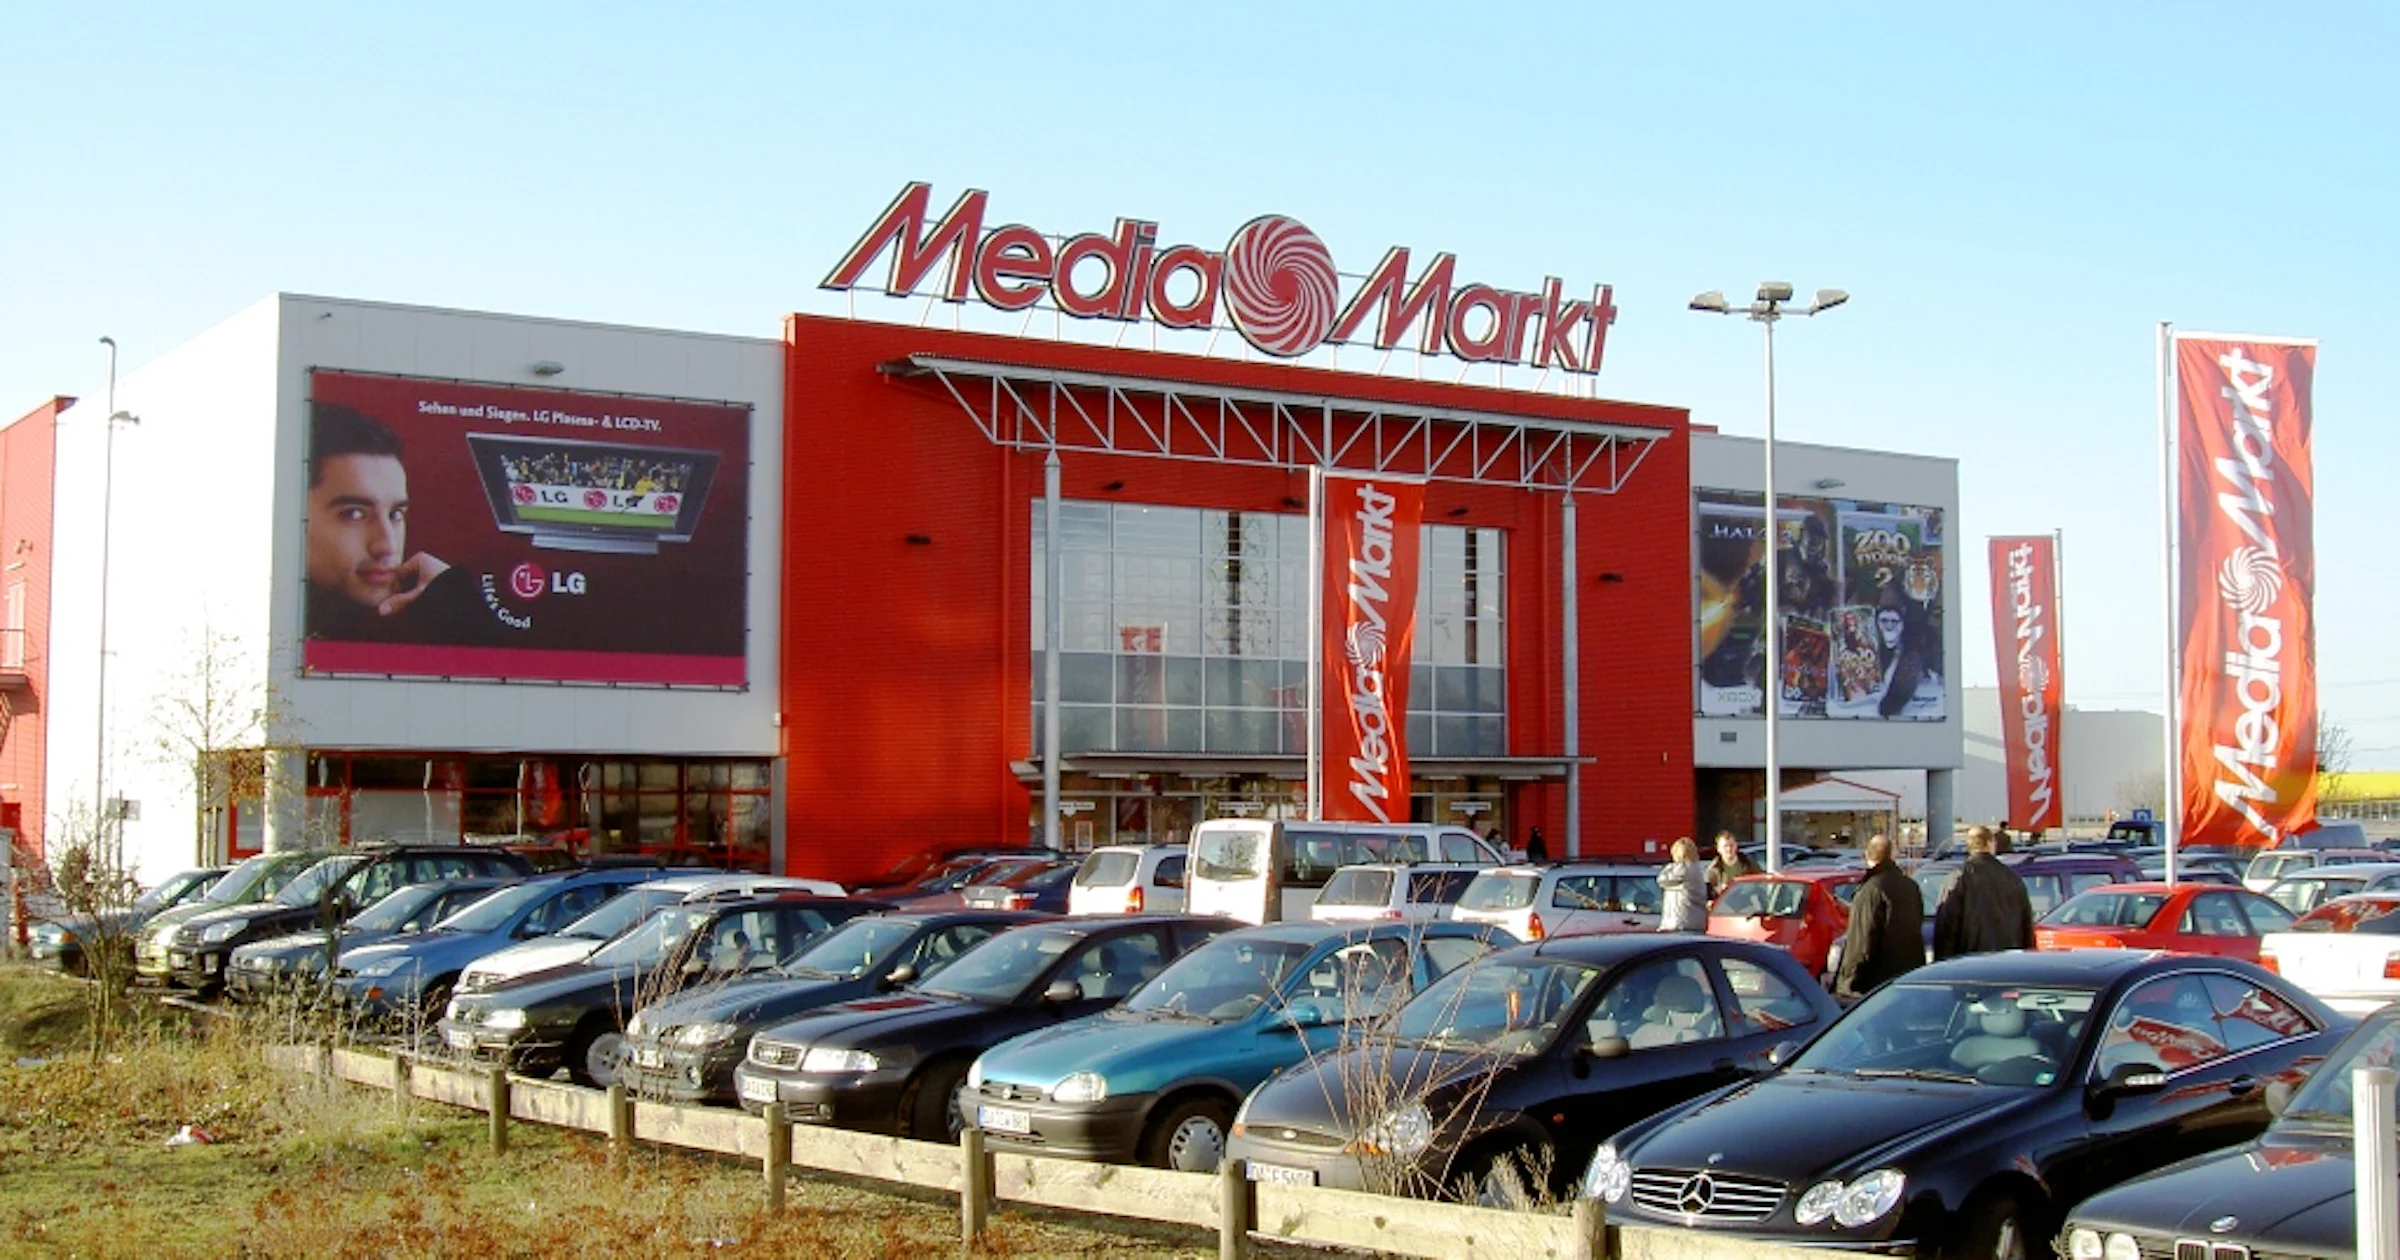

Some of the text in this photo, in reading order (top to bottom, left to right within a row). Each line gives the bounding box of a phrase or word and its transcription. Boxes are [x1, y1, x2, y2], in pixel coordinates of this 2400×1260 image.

[818, 181, 1617, 375] Media Markt
[418, 400, 662, 432] Sehen und Siegen. LG Plasma- & LCD-TV.
[541, 491, 569, 504] LG
[551, 571, 587, 595] LG
[2212, 348, 2283, 841] Media Markt
[498, 607, 532, 629] Good
[1348, 483, 1397, 823] Media Markt
